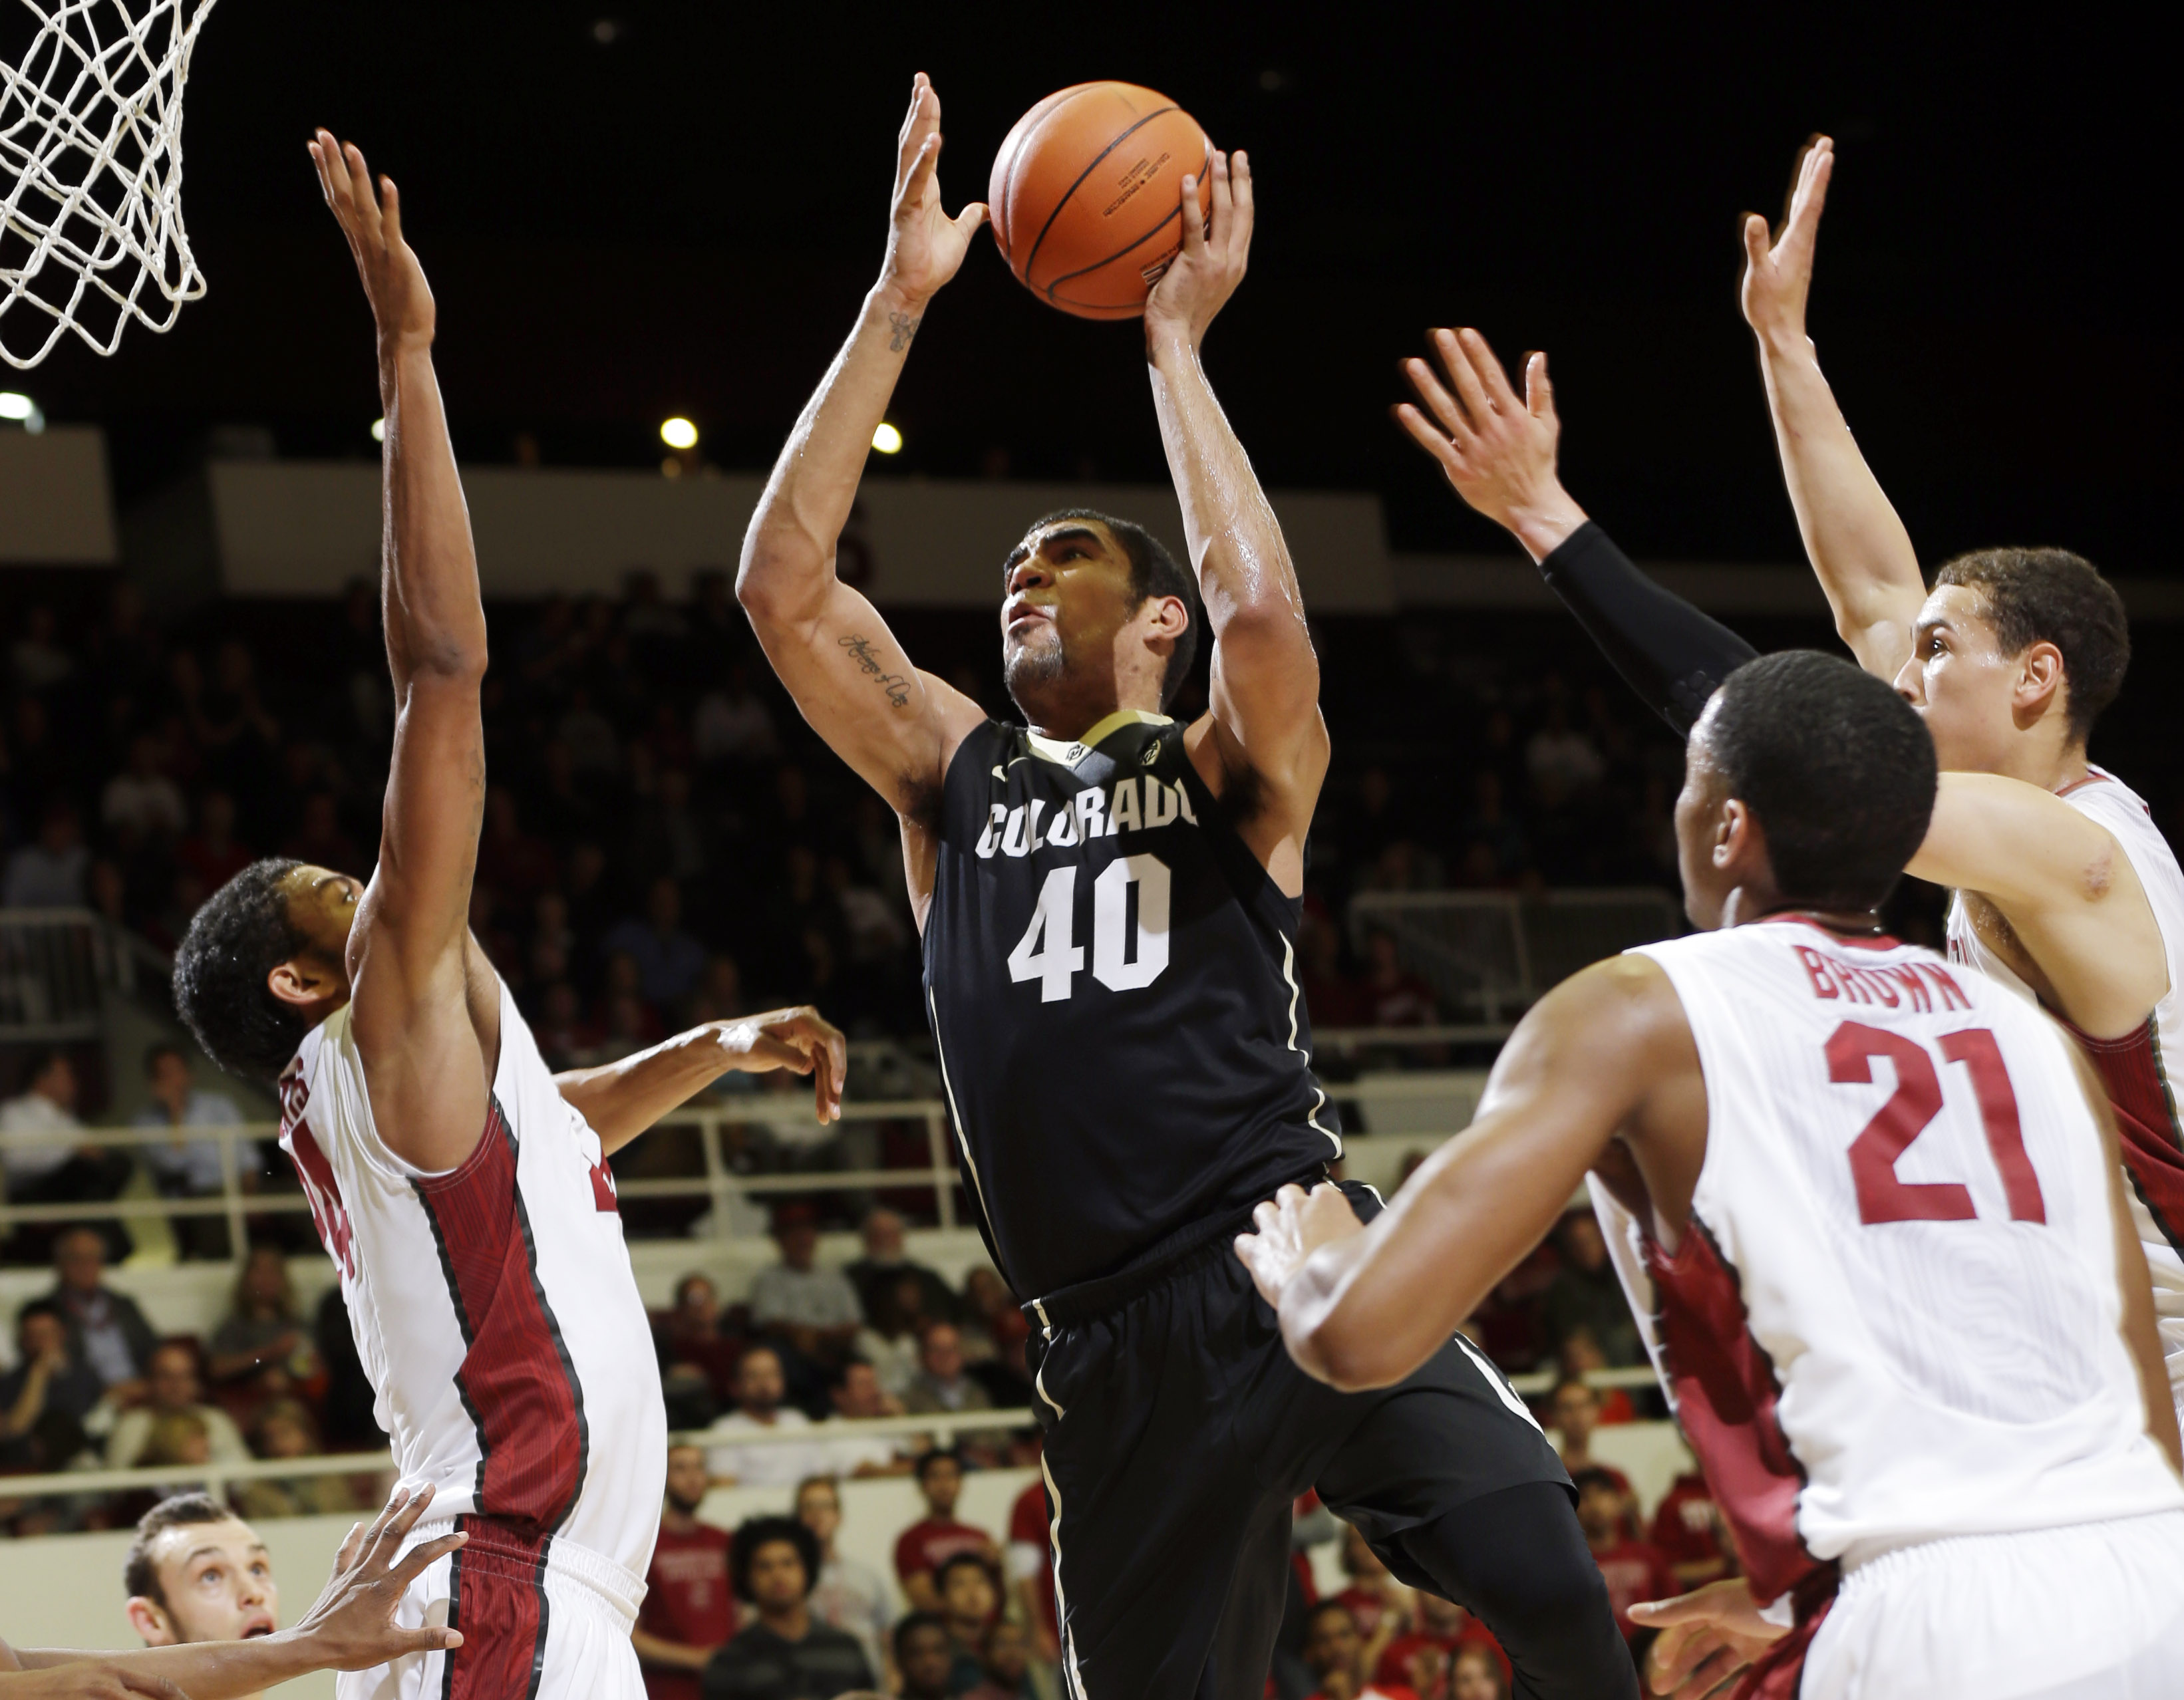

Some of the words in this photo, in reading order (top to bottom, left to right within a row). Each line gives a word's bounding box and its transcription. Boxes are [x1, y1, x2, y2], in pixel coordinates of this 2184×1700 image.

[1007, 853, 1171, 1003] 40
[1791, 944, 1974, 1013] BROWN
[1823, 1020, 2047, 1226] 21
